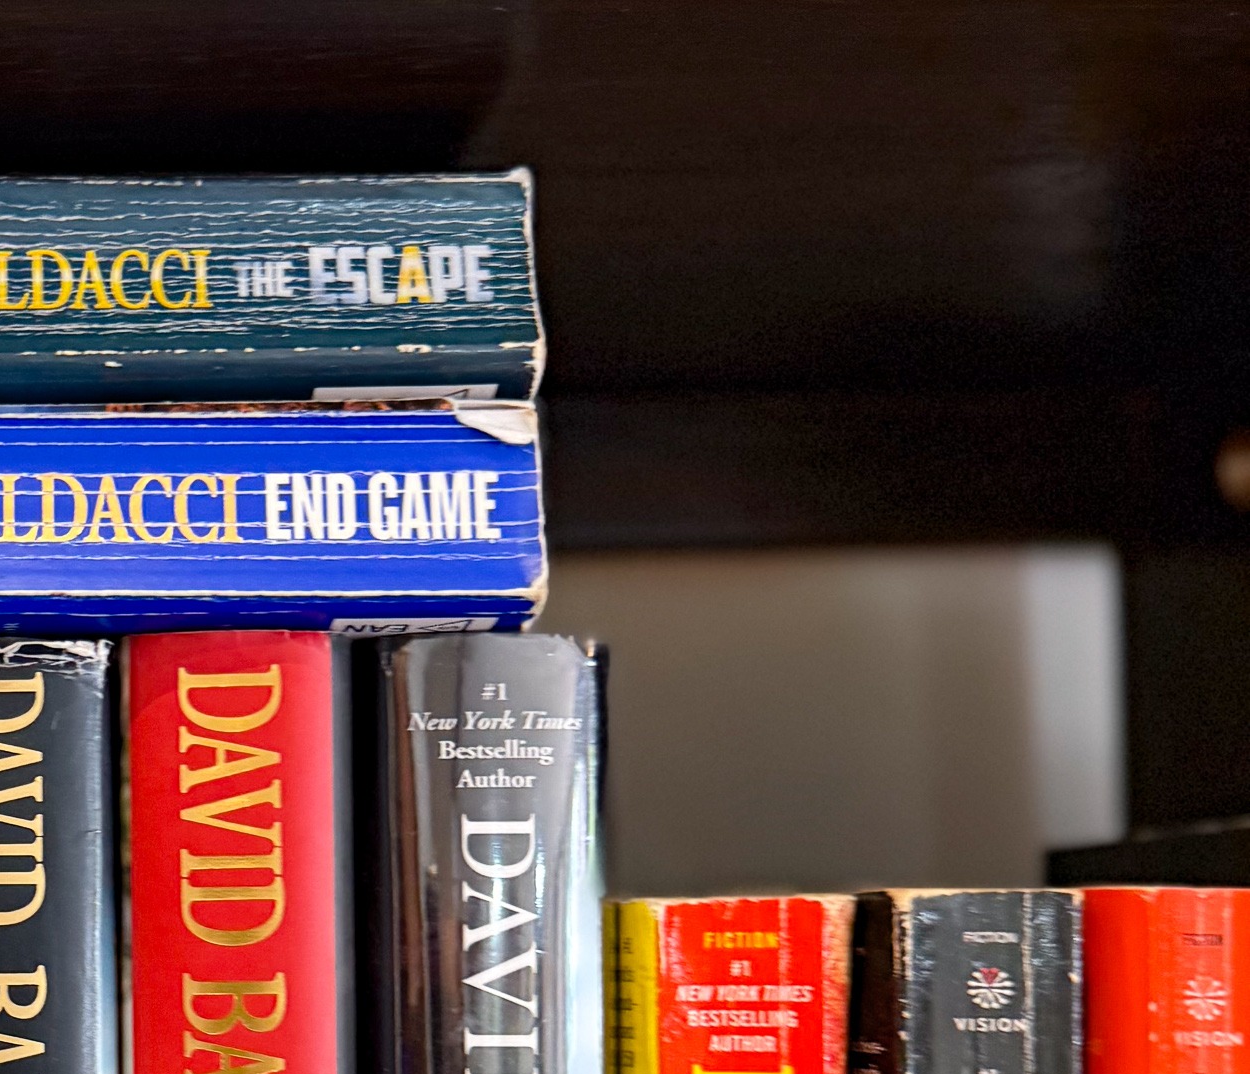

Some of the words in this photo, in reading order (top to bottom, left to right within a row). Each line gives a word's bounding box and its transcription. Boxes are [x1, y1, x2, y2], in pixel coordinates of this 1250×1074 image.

[233, 260, 295, 297] THE
[307, 245, 494, 304] ESCAPE
[265, 472, 363, 540] END
[368, 471, 502, 541] GAME
[481, 683, 508, 701] #1
[408, 713, 457, 731] New
[463, 711, 515, 730] York
[522, 711, 583, 730] Times
[438, 740, 554, 764] Bestselling
[456, 770, 536, 789] Author
[177, 663, 286, 947] DAVID
[703, 931, 779, 949] FICTION
[730, 960, 750, 976] #1
[675, 985, 713, 1002] NEW
[716, 985, 760, 1002] YORK
[763, 985, 814, 1002] TIMES
[687, 1010, 799, 1028] BESTSELLING
[953, 1017, 1030, 1033] VISION
[708, 1035, 778, 1052] AUTHOR
